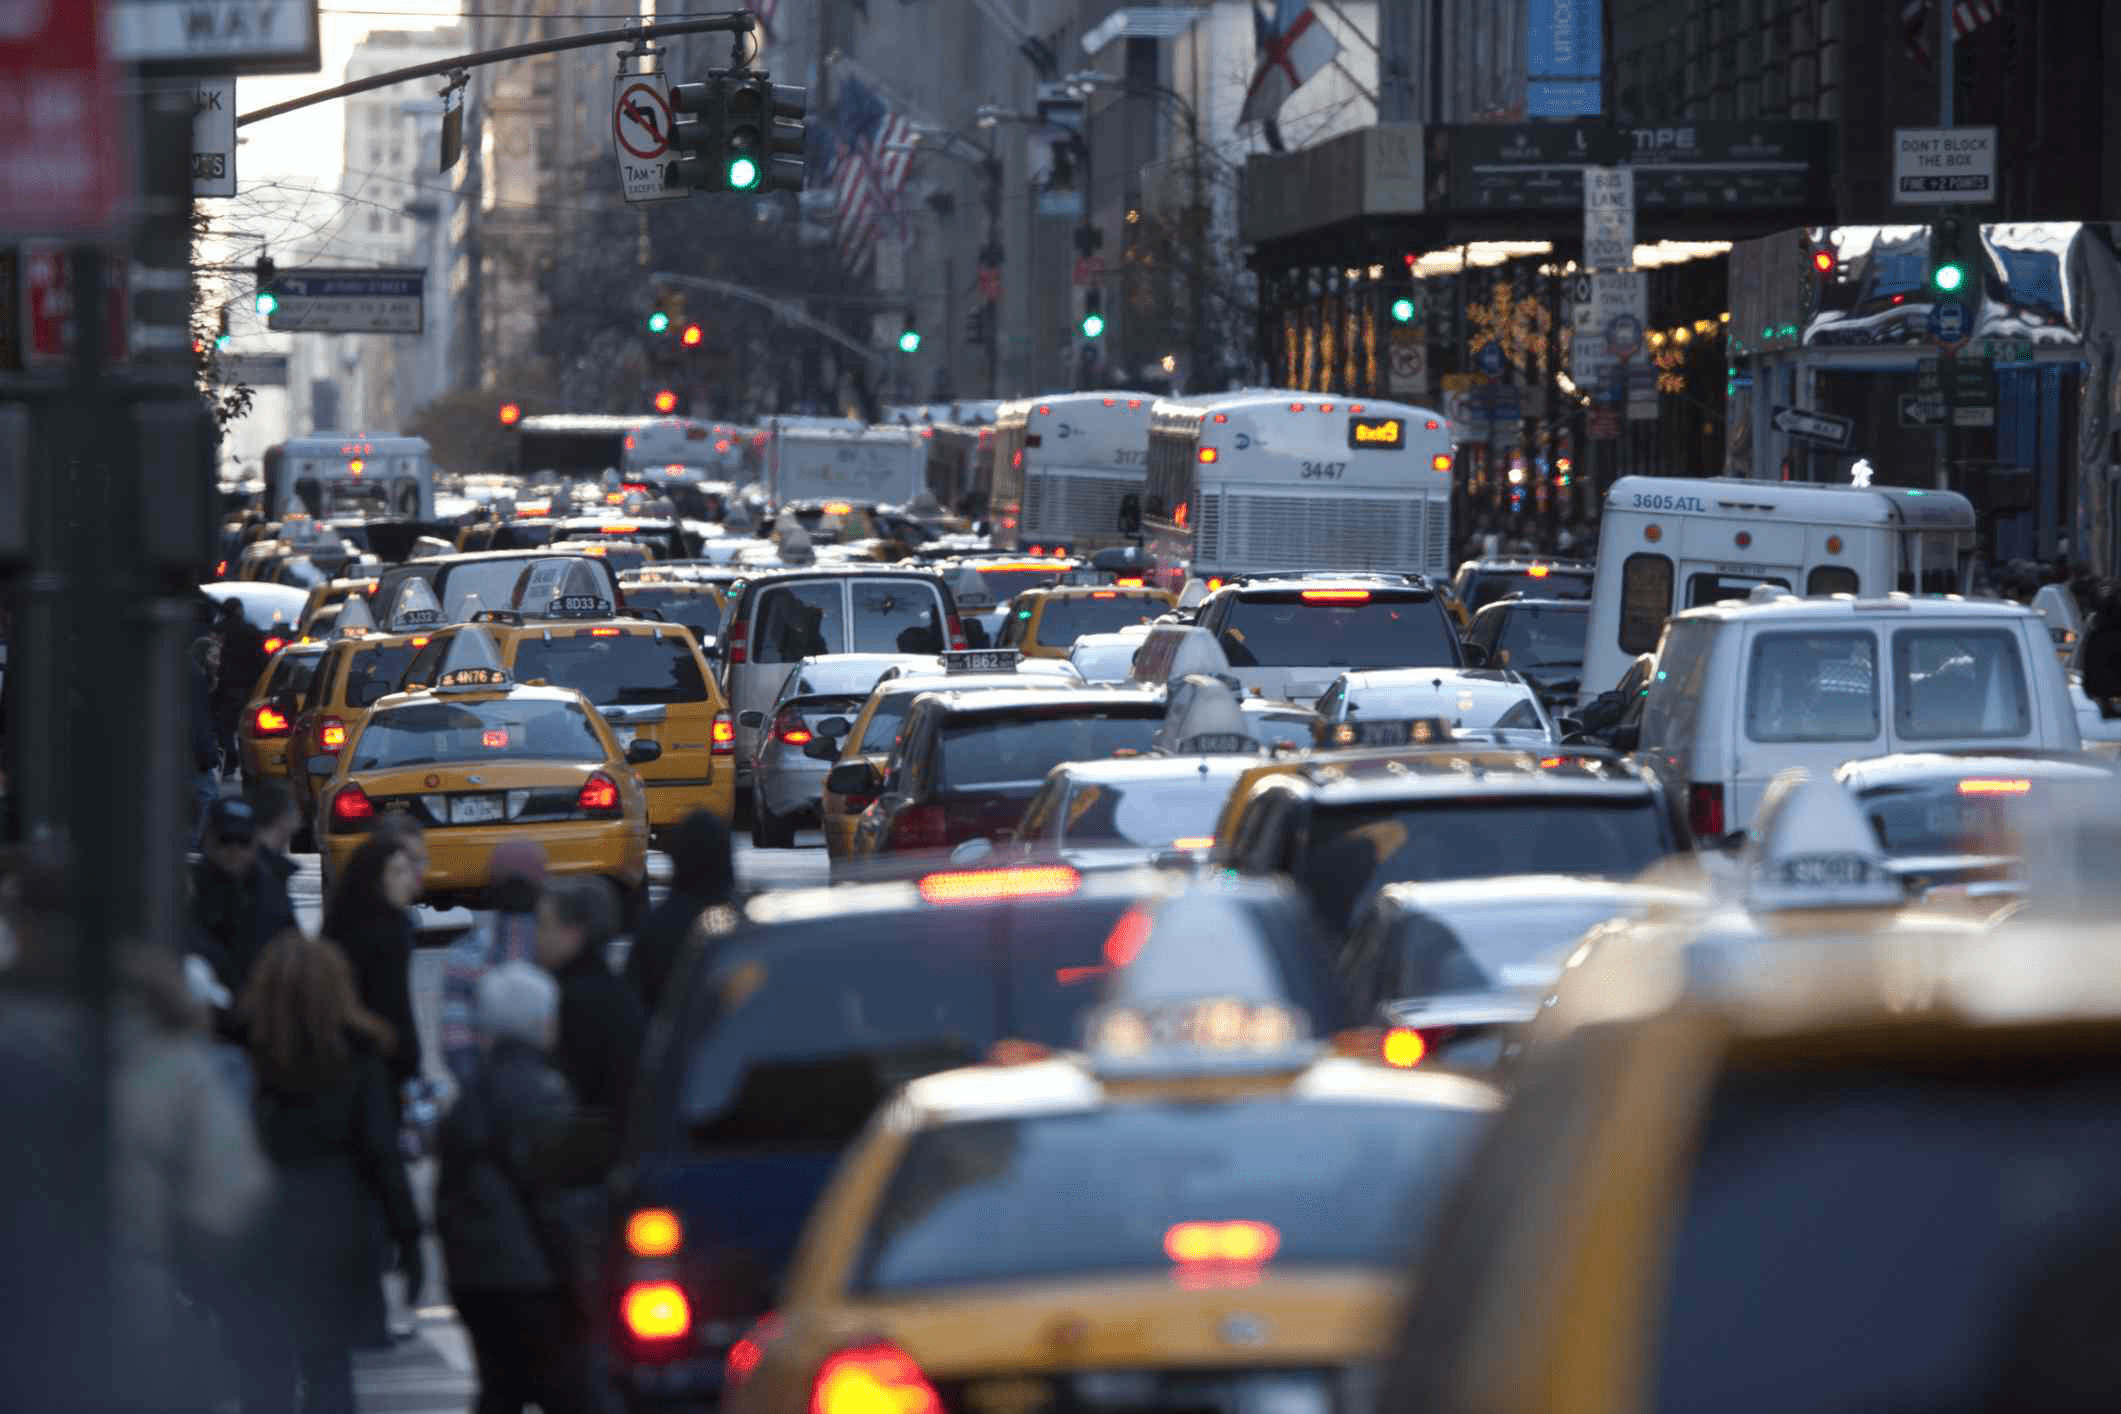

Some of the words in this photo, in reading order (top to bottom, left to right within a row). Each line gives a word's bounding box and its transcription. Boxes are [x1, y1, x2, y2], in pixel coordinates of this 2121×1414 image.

[1943, 138, 1988, 152] BLOCK
[1918, 155, 1942, 167] THE
[1946, 154, 1972, 167] BOX
[1591, 191, 1625, 207] LANE
[1301, 461, 1347, 480] 3447
[566, 597, 594, 610] 8D33
